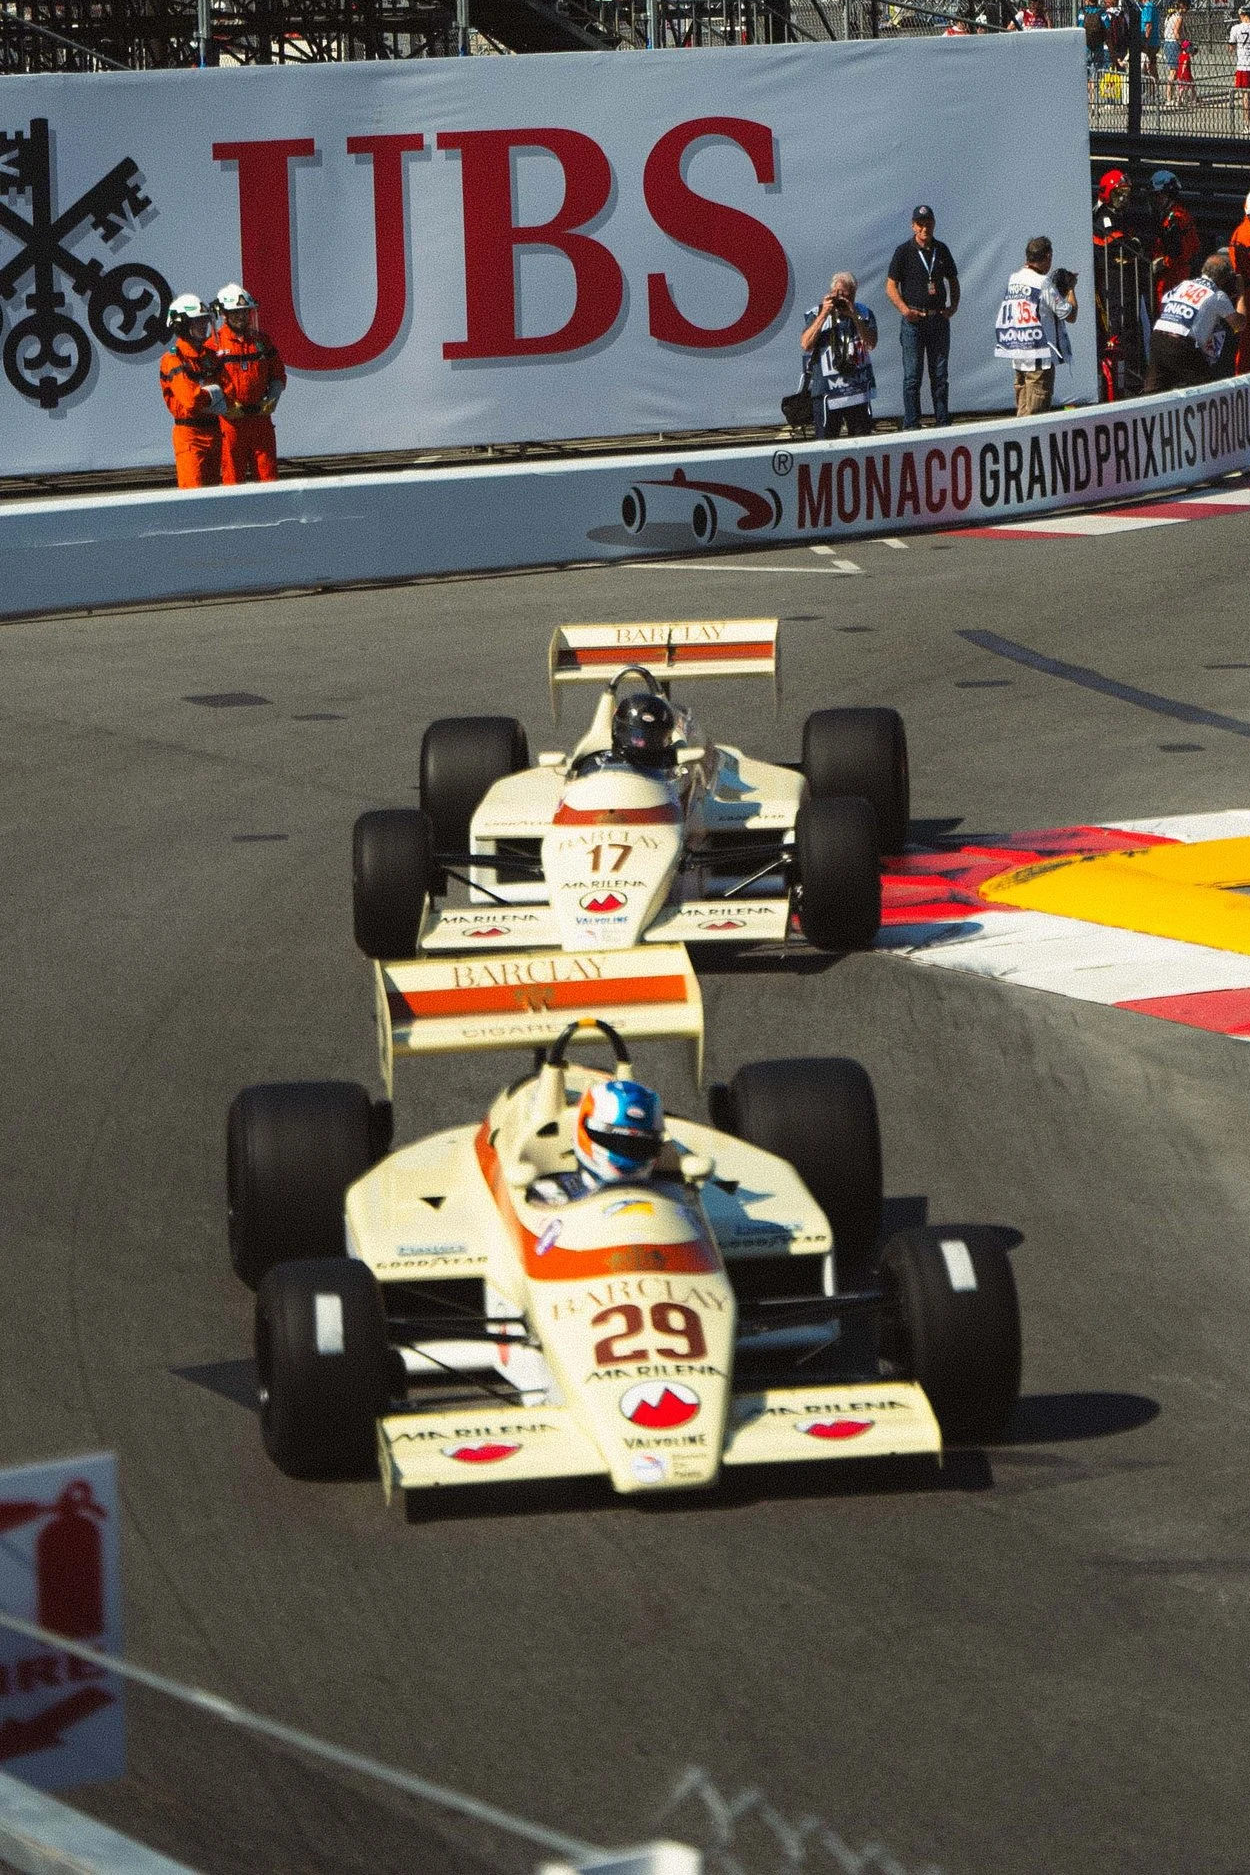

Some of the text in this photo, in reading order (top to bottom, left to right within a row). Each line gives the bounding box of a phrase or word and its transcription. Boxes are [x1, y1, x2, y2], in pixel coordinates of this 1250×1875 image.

[212, 116, 789, 371] UBS
[1180, 283, 1208, 305] 349
[1163, 302, 1195, 320] ONACO
[999, 328, 1043, 343] MONACO
[797, 444, 973, 530] MONACO
[615, 624, 725, 644] BARCLAY
[559, 831, 663, 851] BARCLAY
[586, 843, 633, 873] 17
[561, 879, 648, 889] MARILENA
[440, 914, 540, 924] MARILENA
[575, 916, 629, 925] VALVOLINE
[677, 907, 777, 917] MARILENA
[453, 956, 606, 988] BARCLAY
[552, 1279, 728, 1320] BARCLAY
[591, 1302, 708, 1368] 29
[584, 1364, 728, 1383] MARILENA
[745, 1400, 914, 1419] MARILENA
[392, 1423, 560, 1443] MARILENA
[624, 1433, 707, 1451] VALVOLINE
